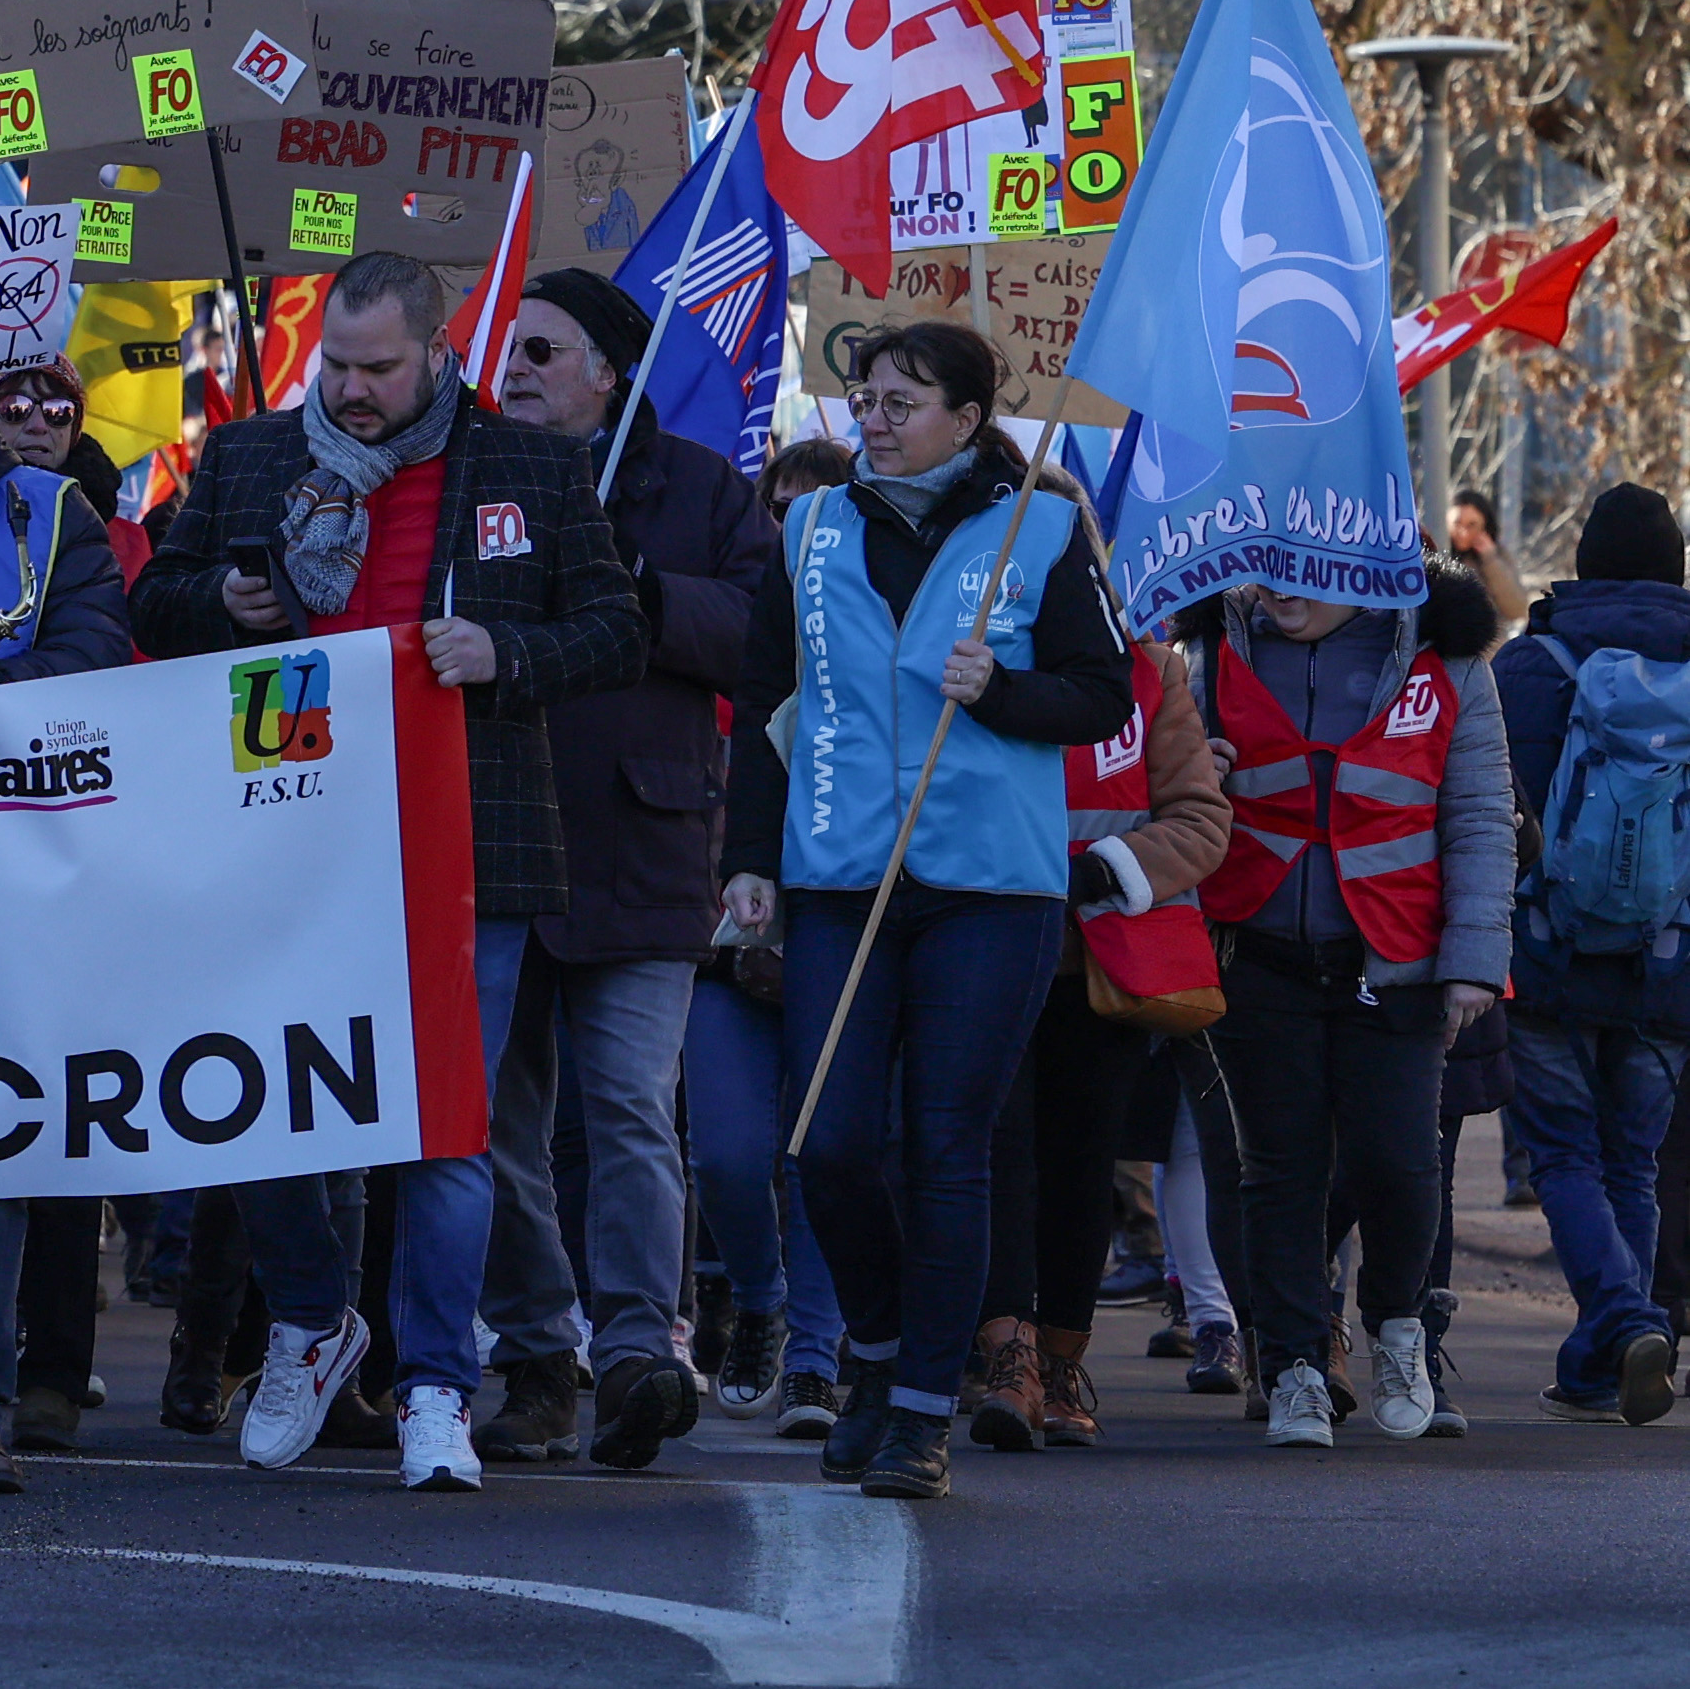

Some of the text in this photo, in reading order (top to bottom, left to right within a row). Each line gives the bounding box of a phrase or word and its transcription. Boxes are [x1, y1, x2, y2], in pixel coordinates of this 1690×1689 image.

[29, 18, 67, 57] les
[367, 39, 390, 57] se
[415, 30, 476, 67] faire
[150, 55, 177, 67] Avec
[242, 39, 288, 85] FO
[151, 68, 192, 115] FO
[277, 117, 388, 167] BRAD
[1002, 154, 1029, 164] Avec
[295, 198, 309, 212] EN
[927, 191, 965, 214] FO
[995, 168, 1040, 211] FO
[81, 227, 119, 238] POUR NOS
[292, 229, 351, 248] RETRAITES
[304, 216, 343, 229] POUR NOS
[897, 213, 959, 238] NON
[478, 503, 523, 558] FO
[1124, 472, 1420, 606] Libres ensemb
[1132, 544, 1424, 629] LA MARQUE AUTONO
[804, 526, 841, 837] www.unsa.org
[1398, 680, 1434, 720] FO
[45, 718, 88, 739] Union
[46, 726, 110, 750] syndicale
[240, 771, 325, 809] F.S.U.
